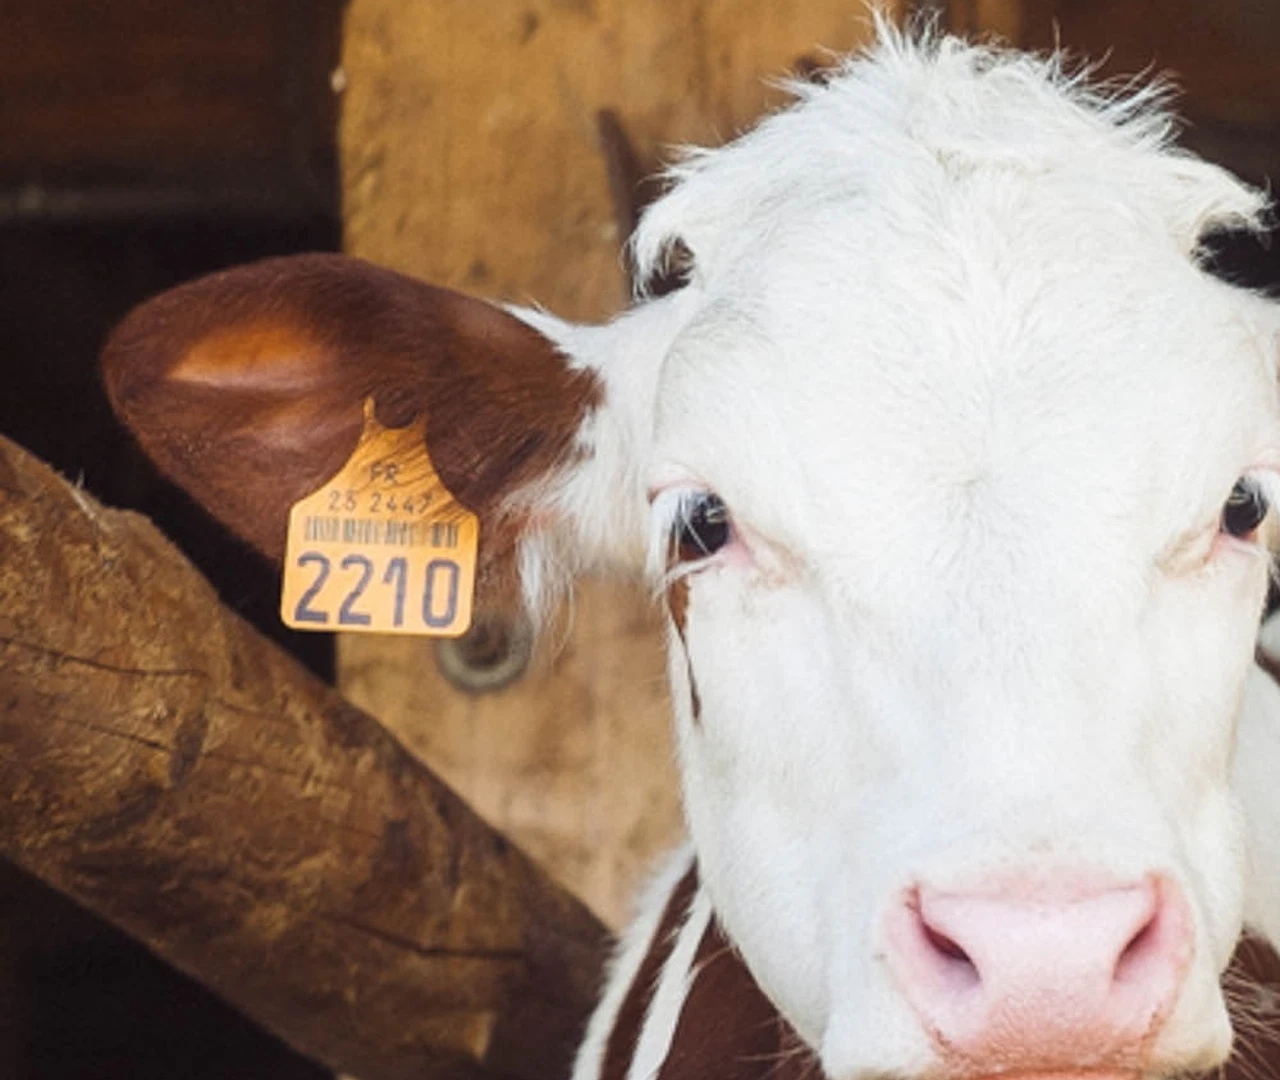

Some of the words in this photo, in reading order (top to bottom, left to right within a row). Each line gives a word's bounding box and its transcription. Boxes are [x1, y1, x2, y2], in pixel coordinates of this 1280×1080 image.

[369, 462, 401, 484] FR
[328, 489, 356, 512] 25
[369, 489, 433, 515] 2447
[294, 551, 460, 628] 2210
